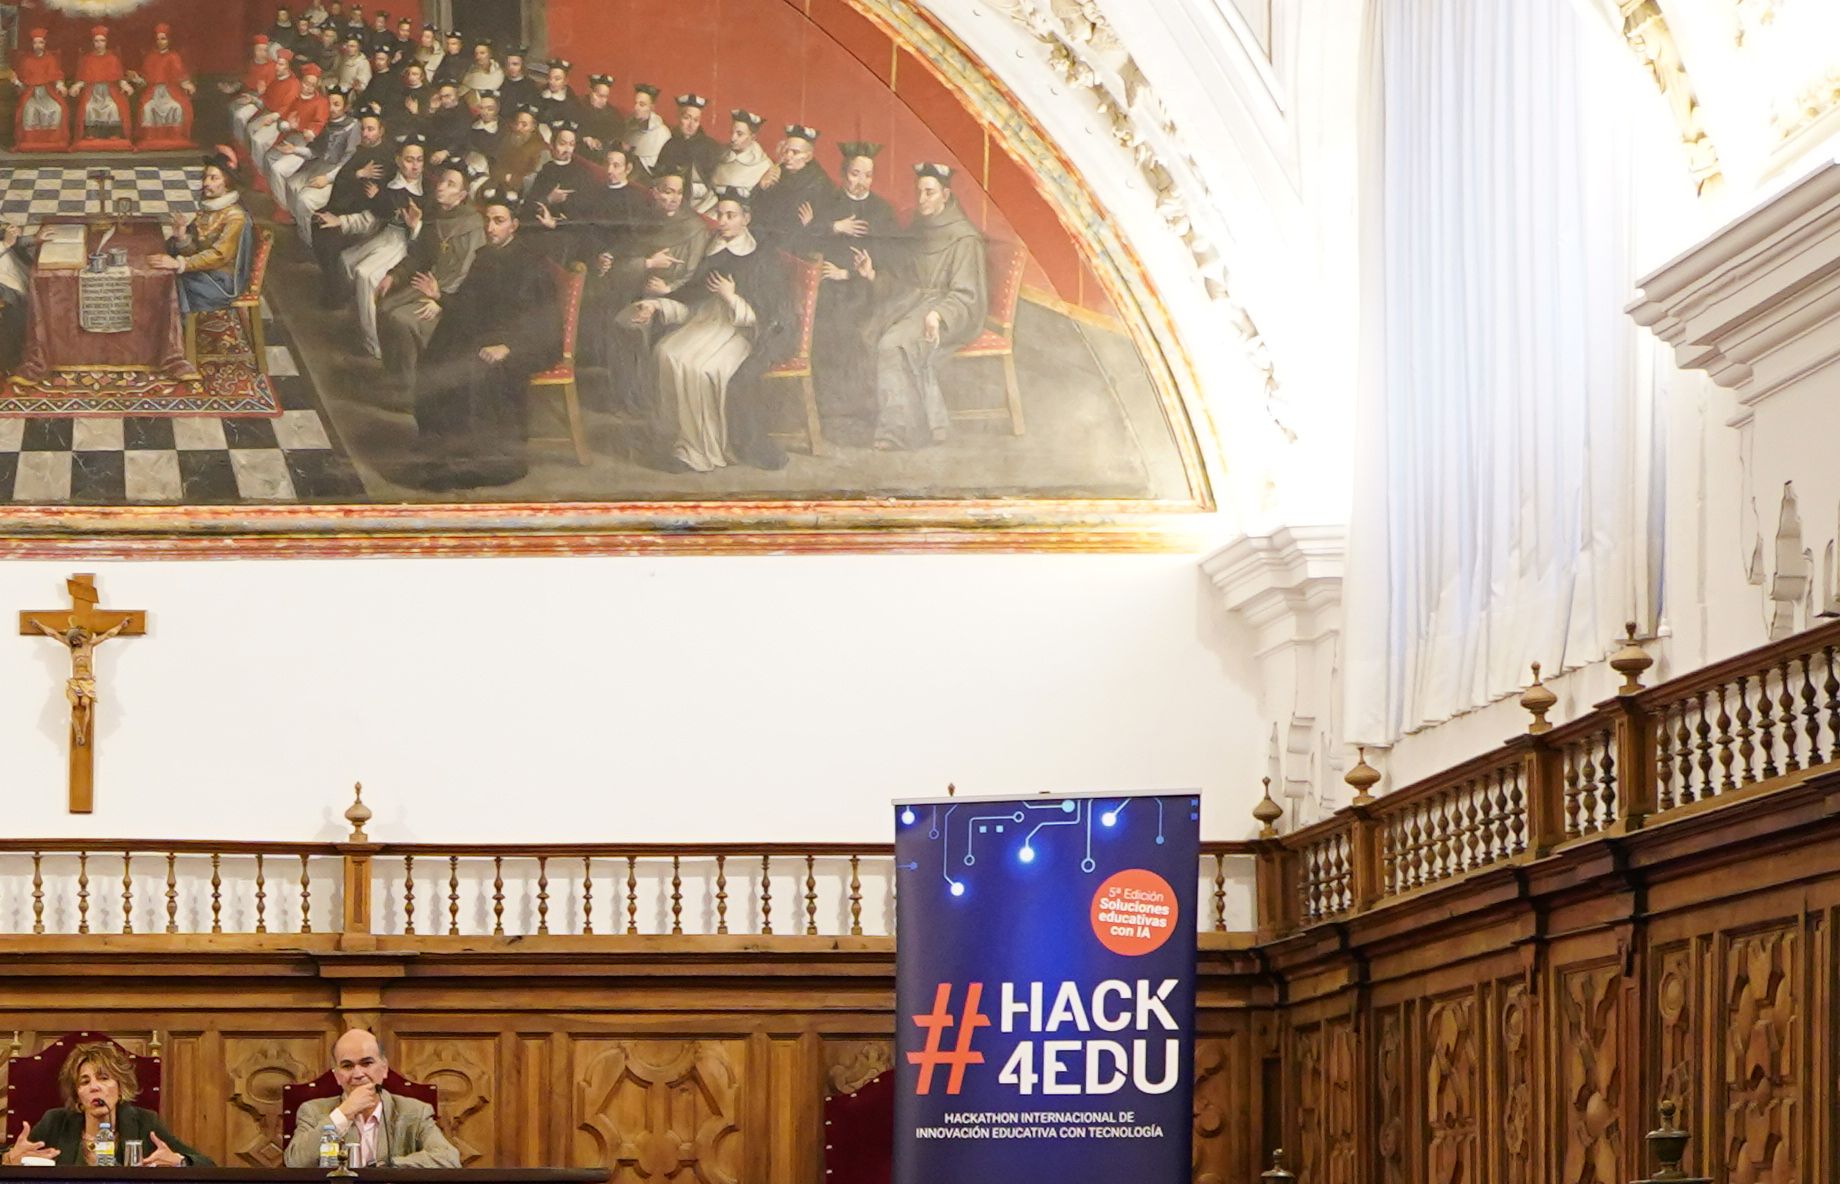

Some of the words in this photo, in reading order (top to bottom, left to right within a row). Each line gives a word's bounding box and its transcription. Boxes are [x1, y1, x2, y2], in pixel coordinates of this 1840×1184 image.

[1123, 888, 1164, 902] Edición
[1099, 898, 1170, 915] Soluciones
[1098, 910, 1167, 928] educativas
[1110, 925, 1134, 937] con
[1136, 926, 1151, 939] IA
[1000, 979, 1180, 1033] HACK
[998, 1039, 1179, 1095] 4EDU
[944, 1112, 1019, 1124] HACKATHON
[1021, 1111, 1116, 1124] INTERNACIONAL
[1119, 1111, 1135, 1123] DE
[915, 1126, 990, 1139] INNOVACIÓN
[992, 1127, 1057, 1138] EDUCATIVA
[1059, 1127, 1086, 1138] CON
[1089, 1124, 1164, 1138] TECNOLOGÍA
